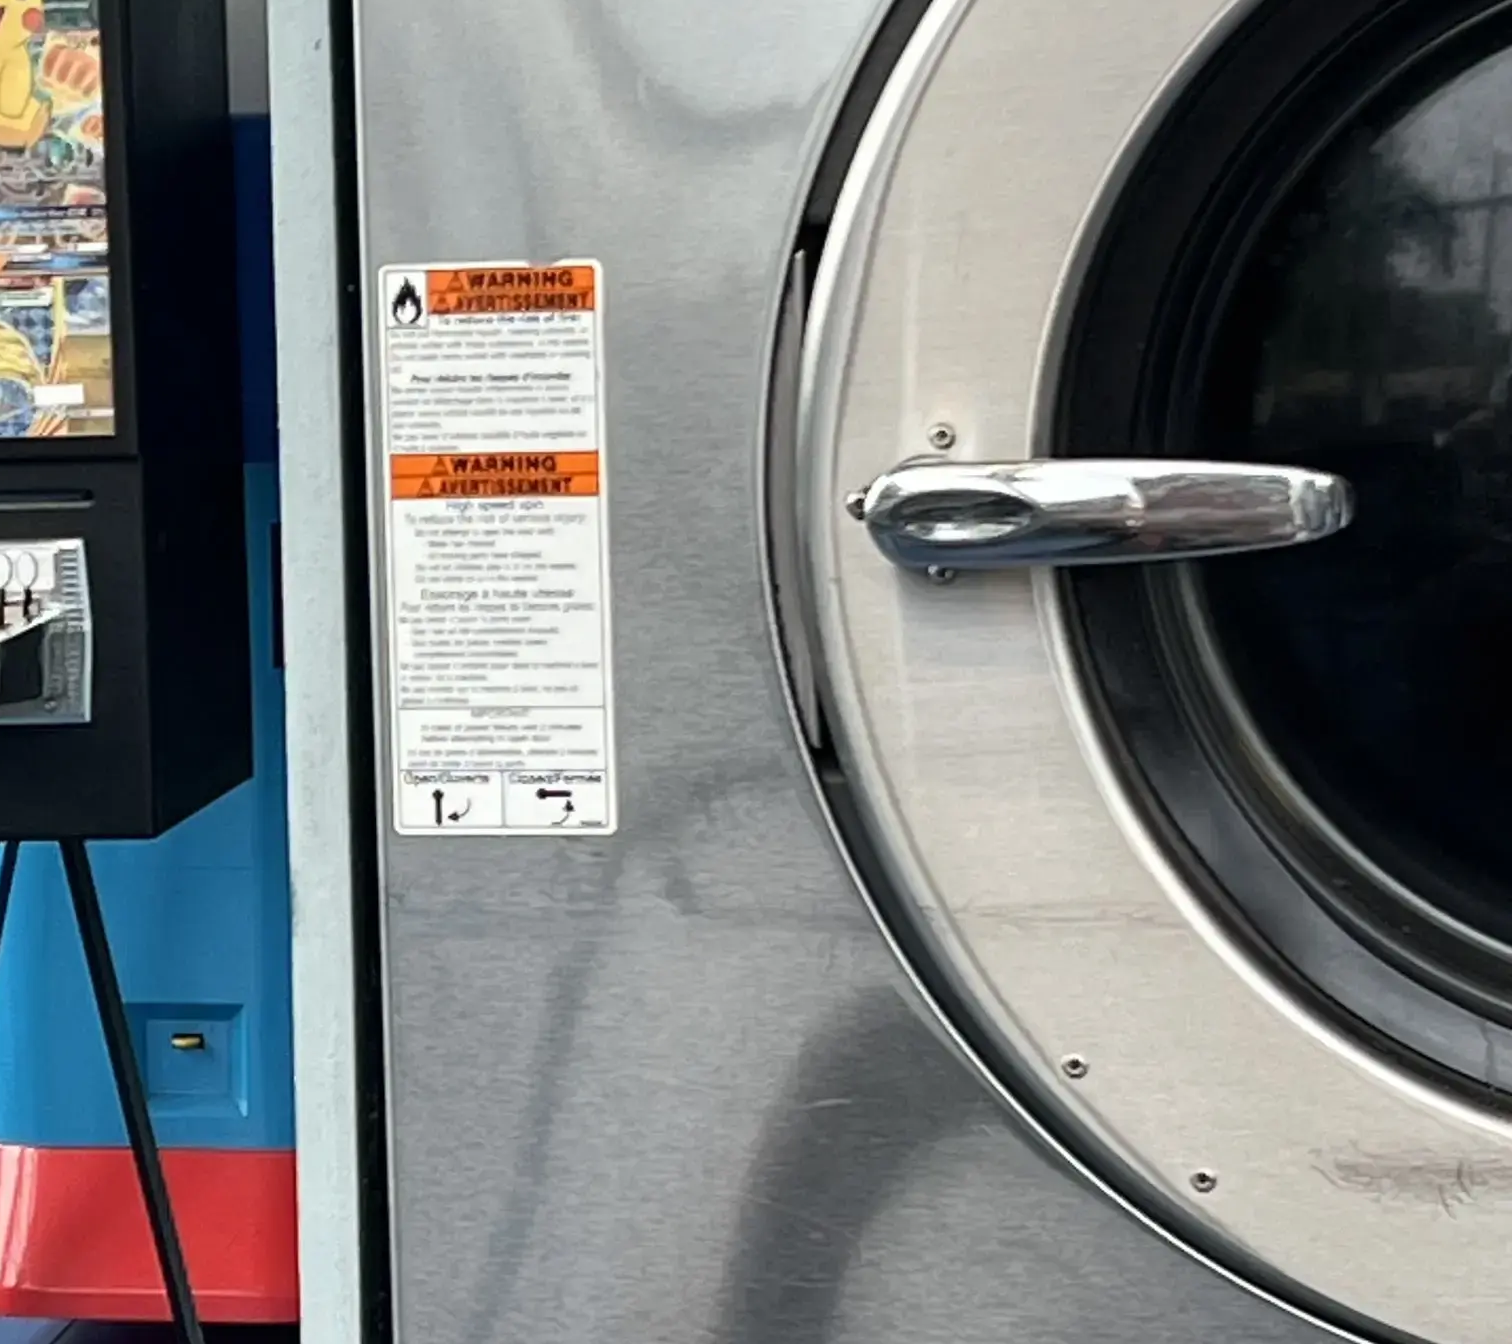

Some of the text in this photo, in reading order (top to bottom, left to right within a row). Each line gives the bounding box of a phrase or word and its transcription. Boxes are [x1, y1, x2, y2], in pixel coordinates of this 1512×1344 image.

[466, 269, 574, 289] WARNING
[454, 292, 588, 311] AVERTISSEMENT
[451, 455, 557, 473] WARNING
[439, 476, 573, 495] AVERTISSEMENT
